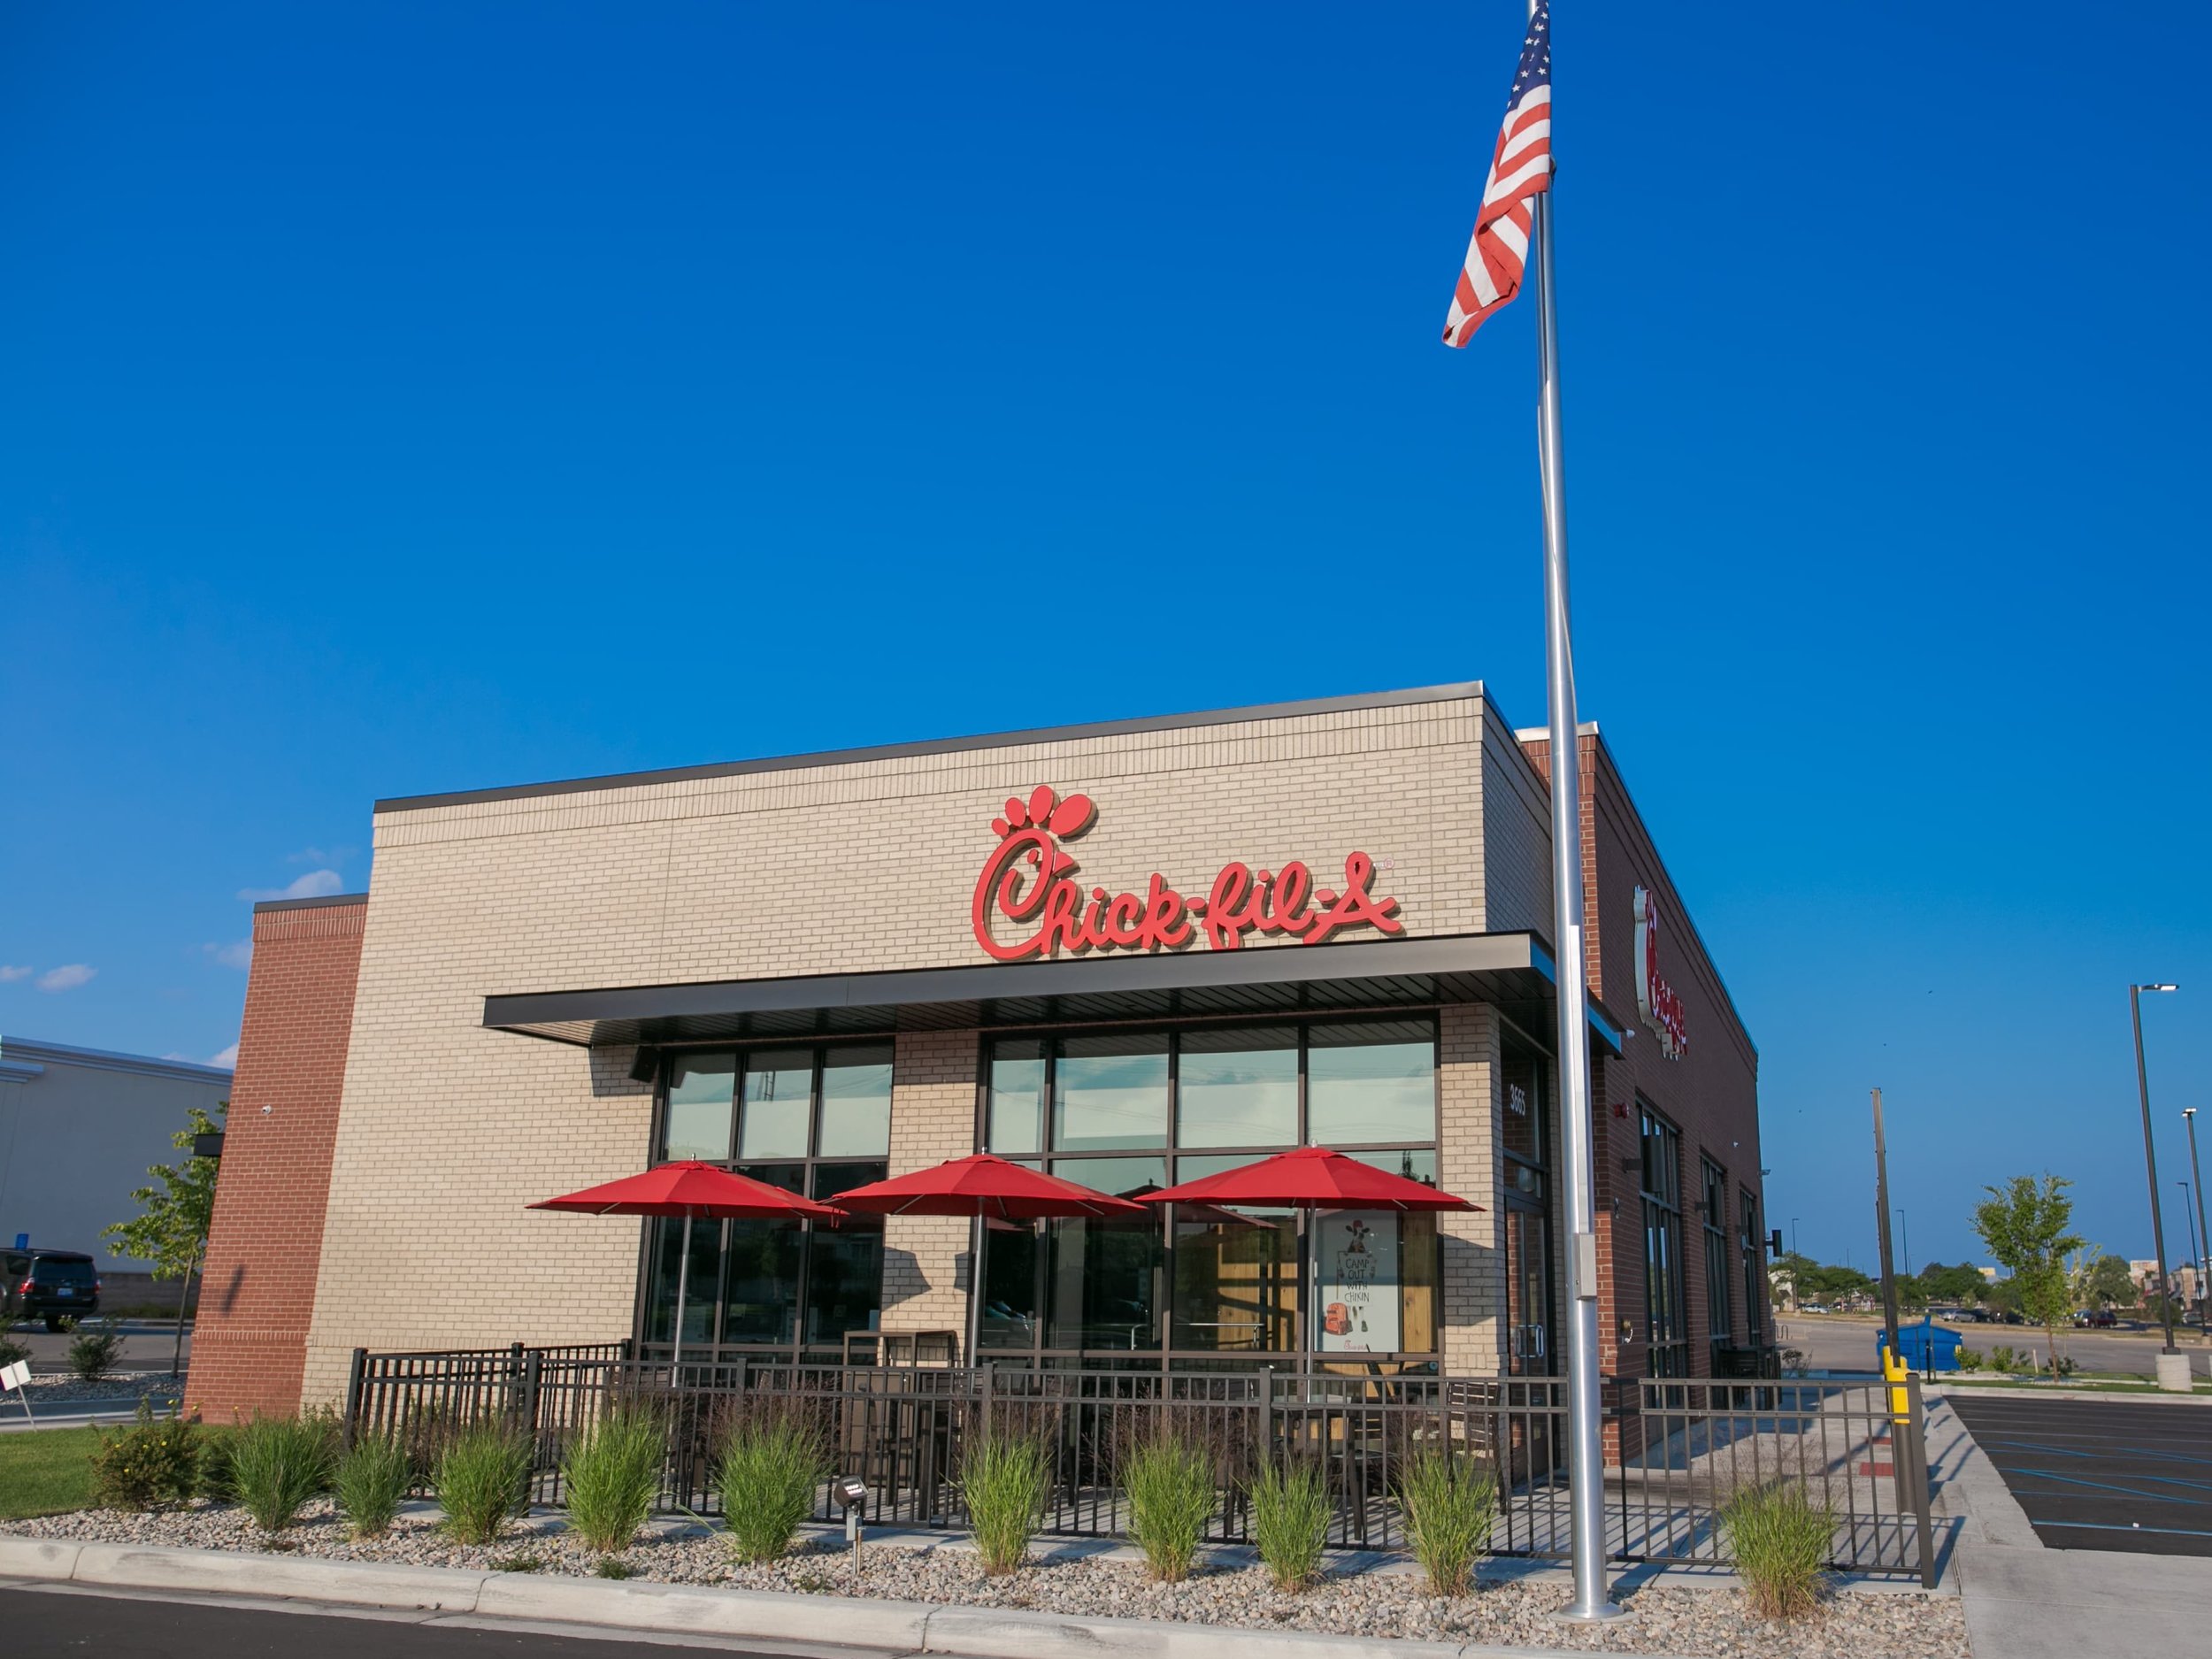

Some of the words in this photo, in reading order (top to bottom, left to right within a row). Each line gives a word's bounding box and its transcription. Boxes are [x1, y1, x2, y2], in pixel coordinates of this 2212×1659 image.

[972, 786, 1402, 961] Chick-fil-A
[1510, 1083, 1526, 1117] 3665
[1345, 1258, 1370, 1269] CAMP
[1348, 1270, 1365, 1279] OUT
[1346, 1280, 1368, 1291] WITH
[1344, 1292, 1370, 1302] CHIKIN
